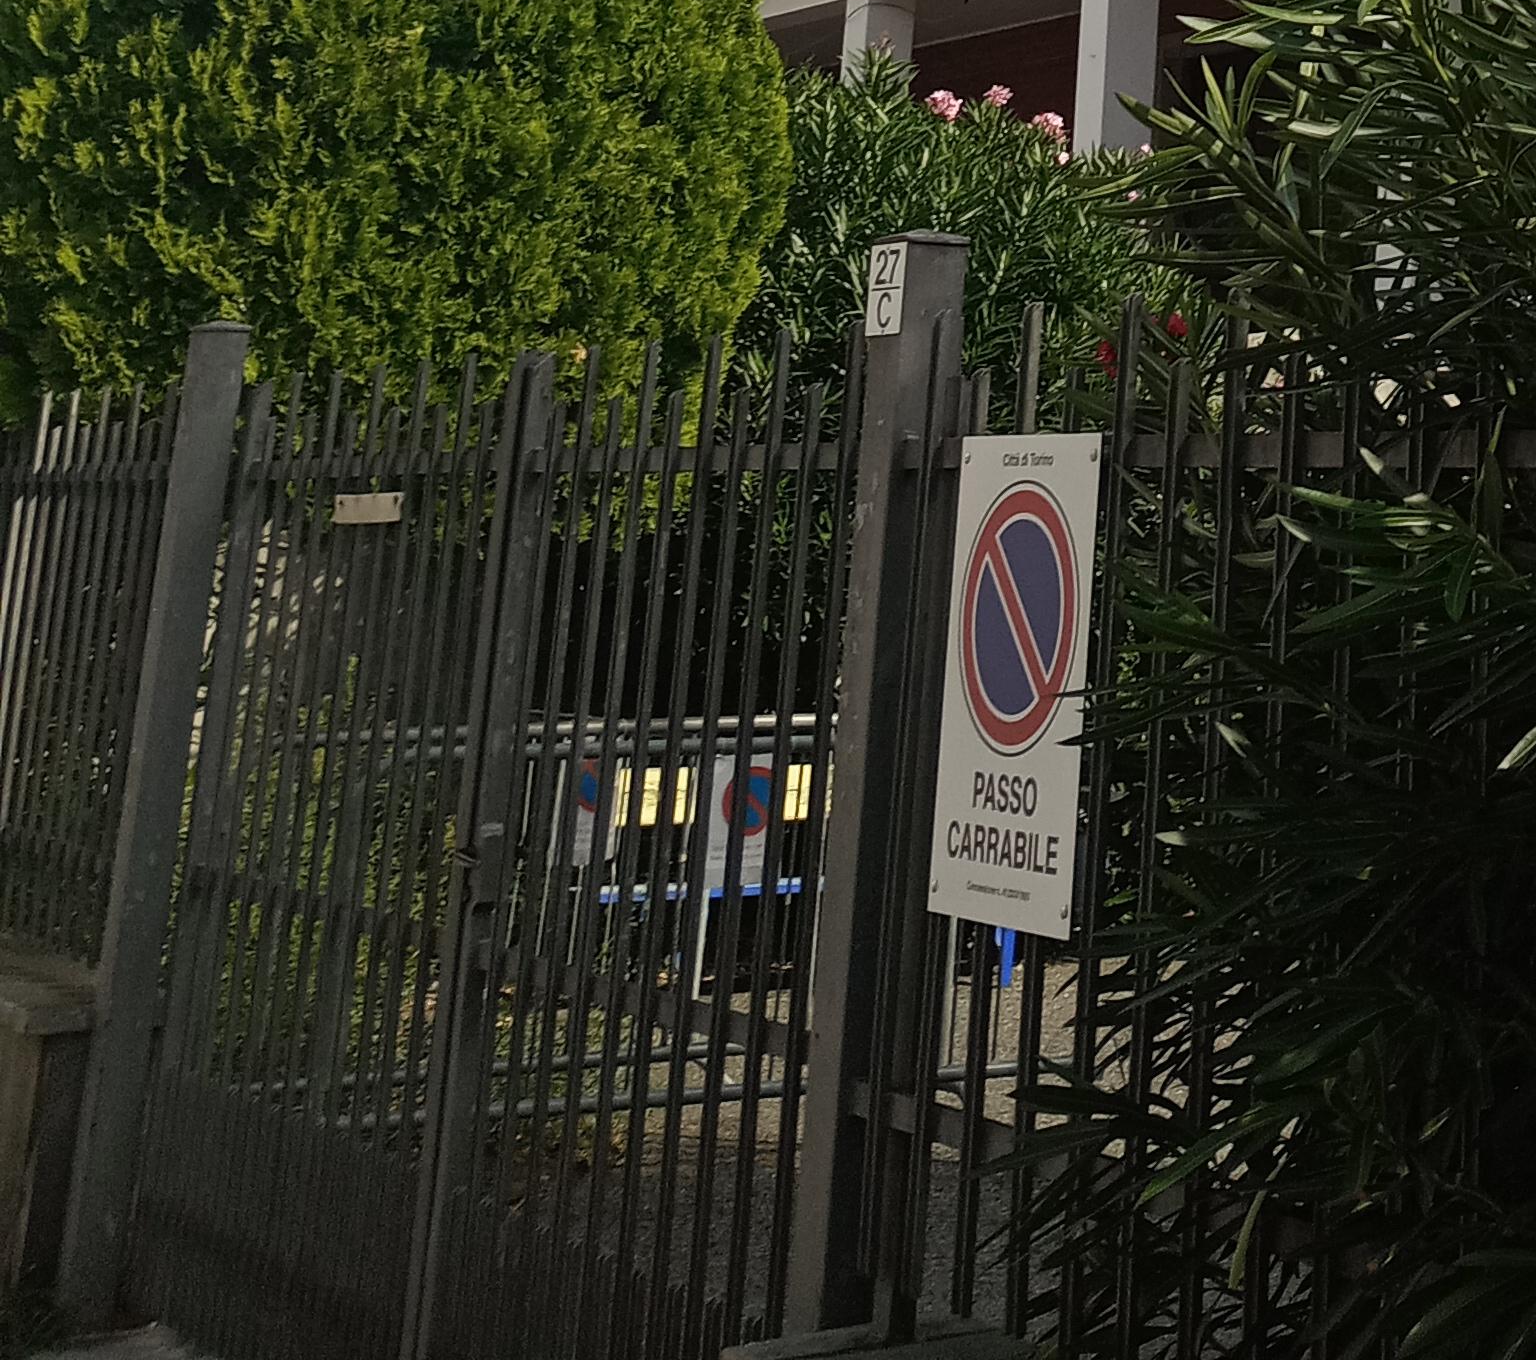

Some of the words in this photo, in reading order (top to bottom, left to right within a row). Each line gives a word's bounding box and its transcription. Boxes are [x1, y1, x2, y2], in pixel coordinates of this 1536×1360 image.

[874, 248, 901, 285] 27
[877, 291, 892, 329] C
[972, 771, 1038, 817] PASSO
[947, 820, 1060, 876] CARRABILE
